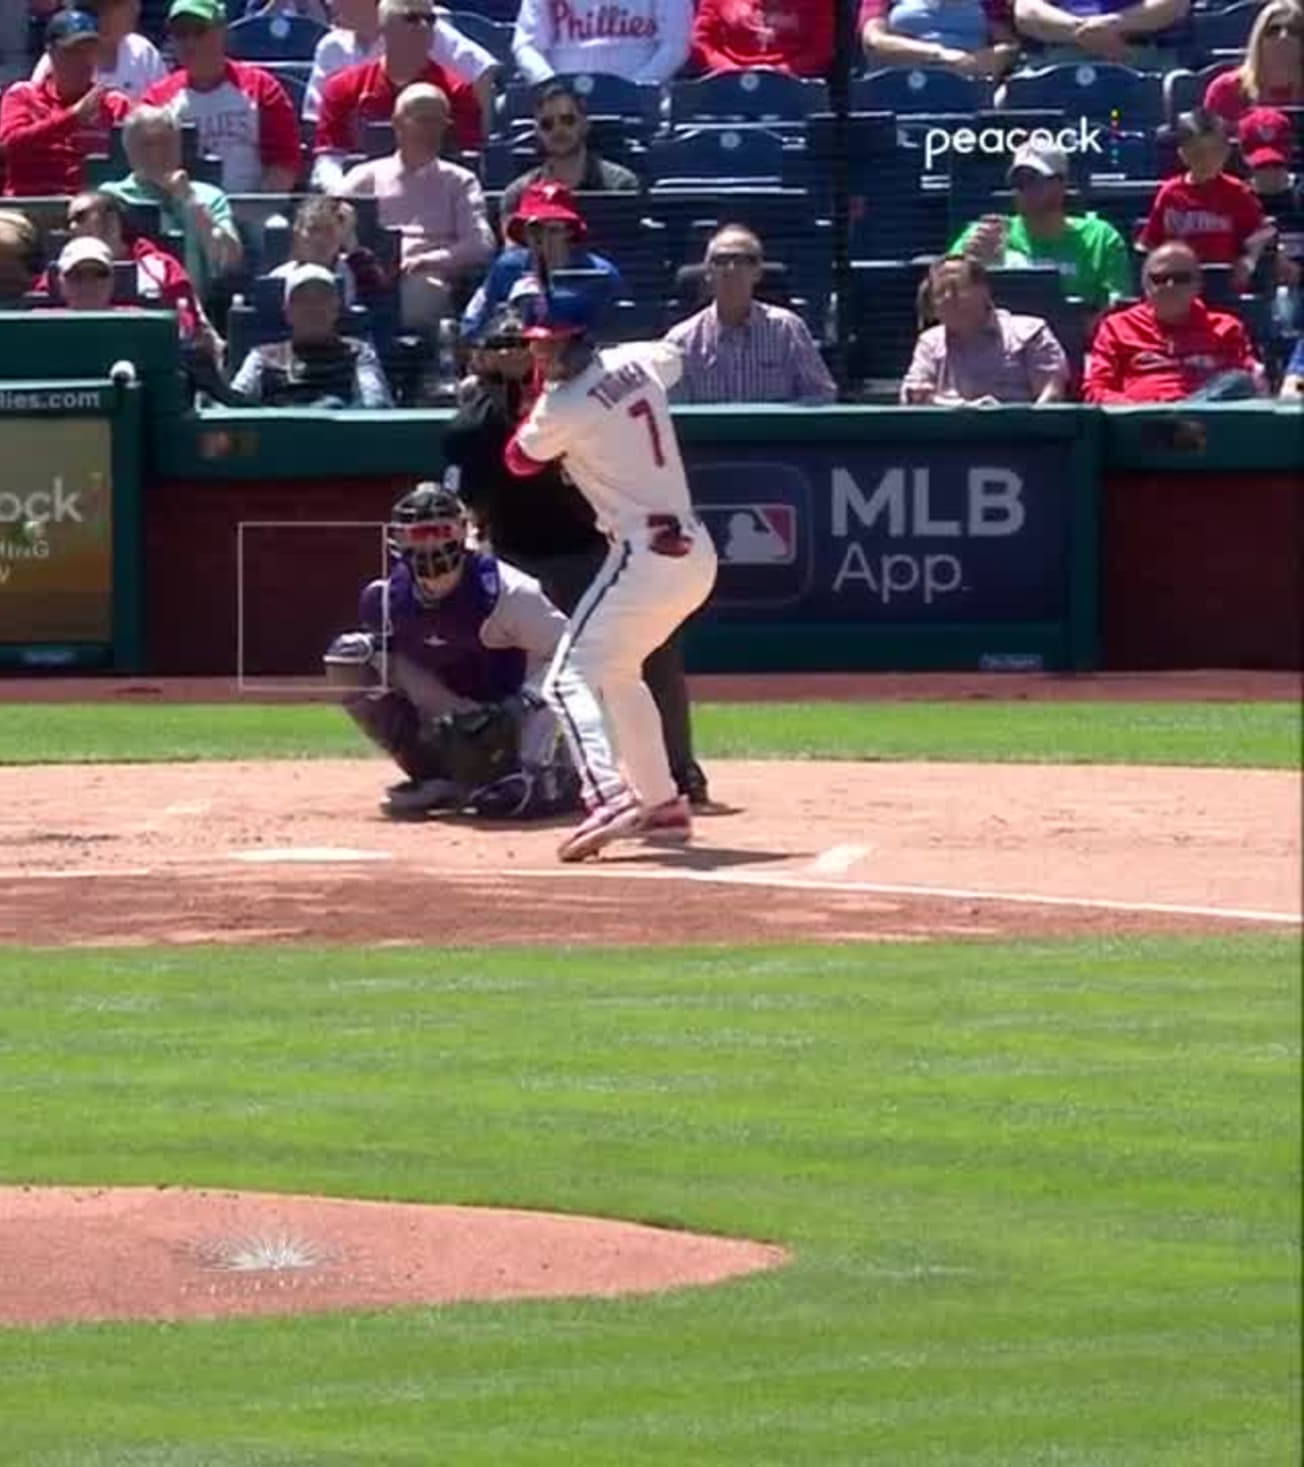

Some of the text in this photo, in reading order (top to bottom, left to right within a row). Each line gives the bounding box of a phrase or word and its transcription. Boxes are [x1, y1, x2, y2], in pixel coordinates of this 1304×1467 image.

[552, 3, 658, 41] Phillies
[628, 397, 666, 469] 7
[831, 467, 1026, 538] MLB
